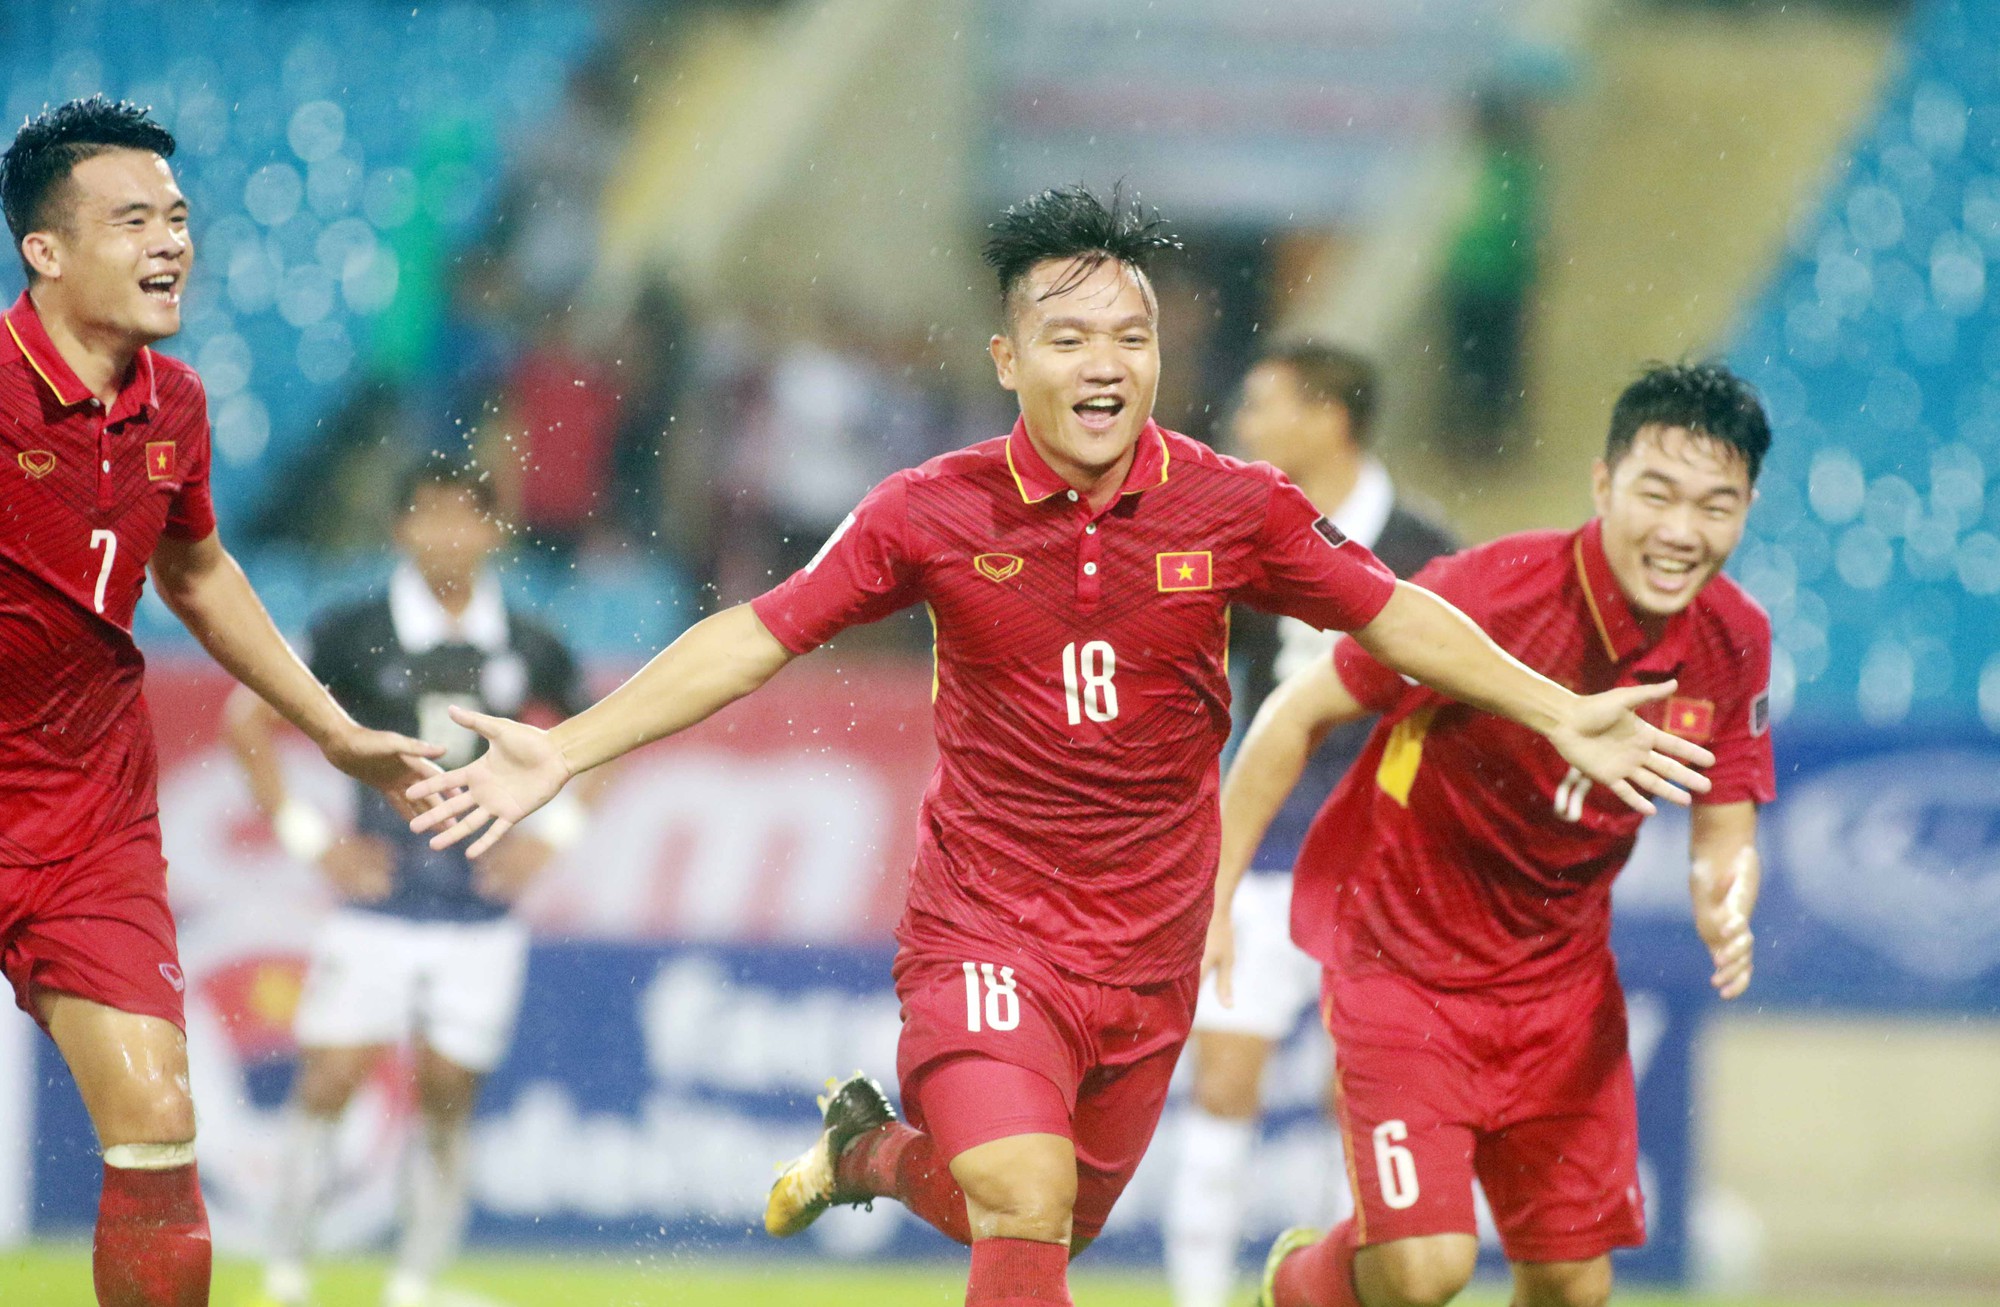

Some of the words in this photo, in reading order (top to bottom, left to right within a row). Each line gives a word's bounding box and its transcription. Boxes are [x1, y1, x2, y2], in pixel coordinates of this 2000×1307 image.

[89, 529, 117, 614] 7
[1061, 640, 1119, 726] 18
[962, 961, 1020, 1033] 18
[1372, 1119, 1420, 1210] 6
